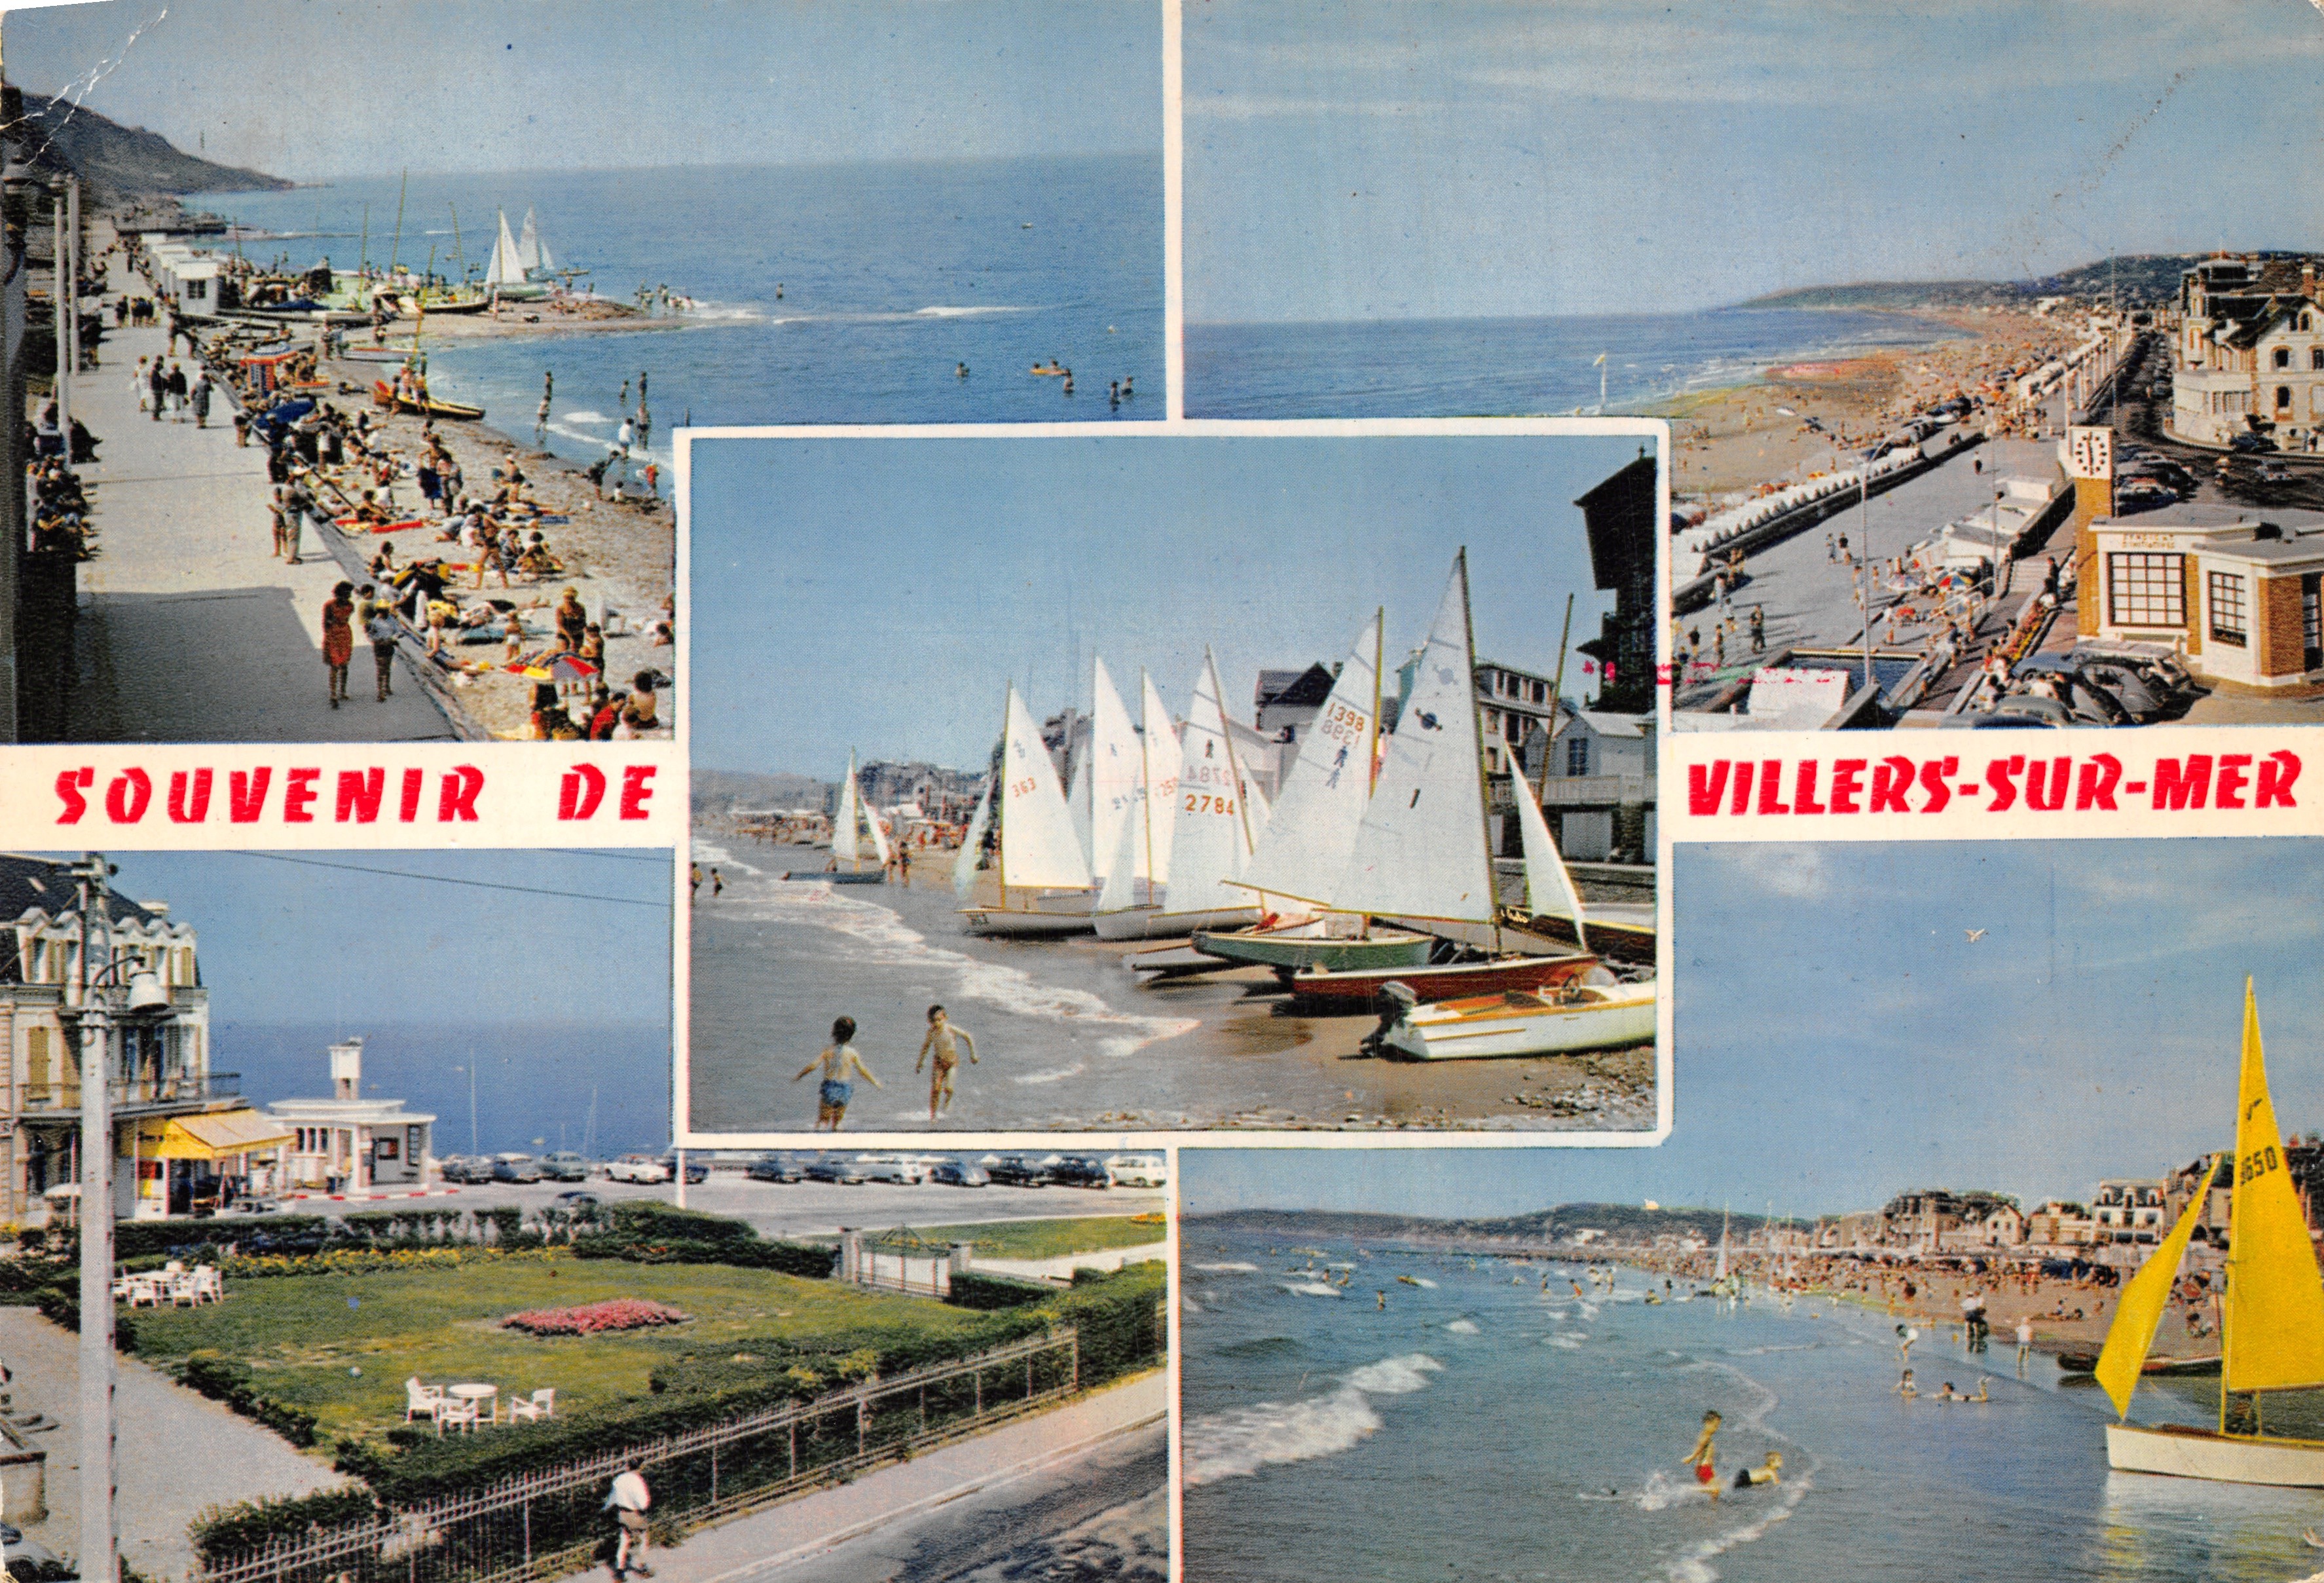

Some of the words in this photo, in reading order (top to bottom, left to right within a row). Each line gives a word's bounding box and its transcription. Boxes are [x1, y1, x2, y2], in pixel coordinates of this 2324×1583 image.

[1327, 702, 1365, 732] 1398
[1011, 776, 1036, 798] 363
[1185, 793, 1234, 816] 2784
